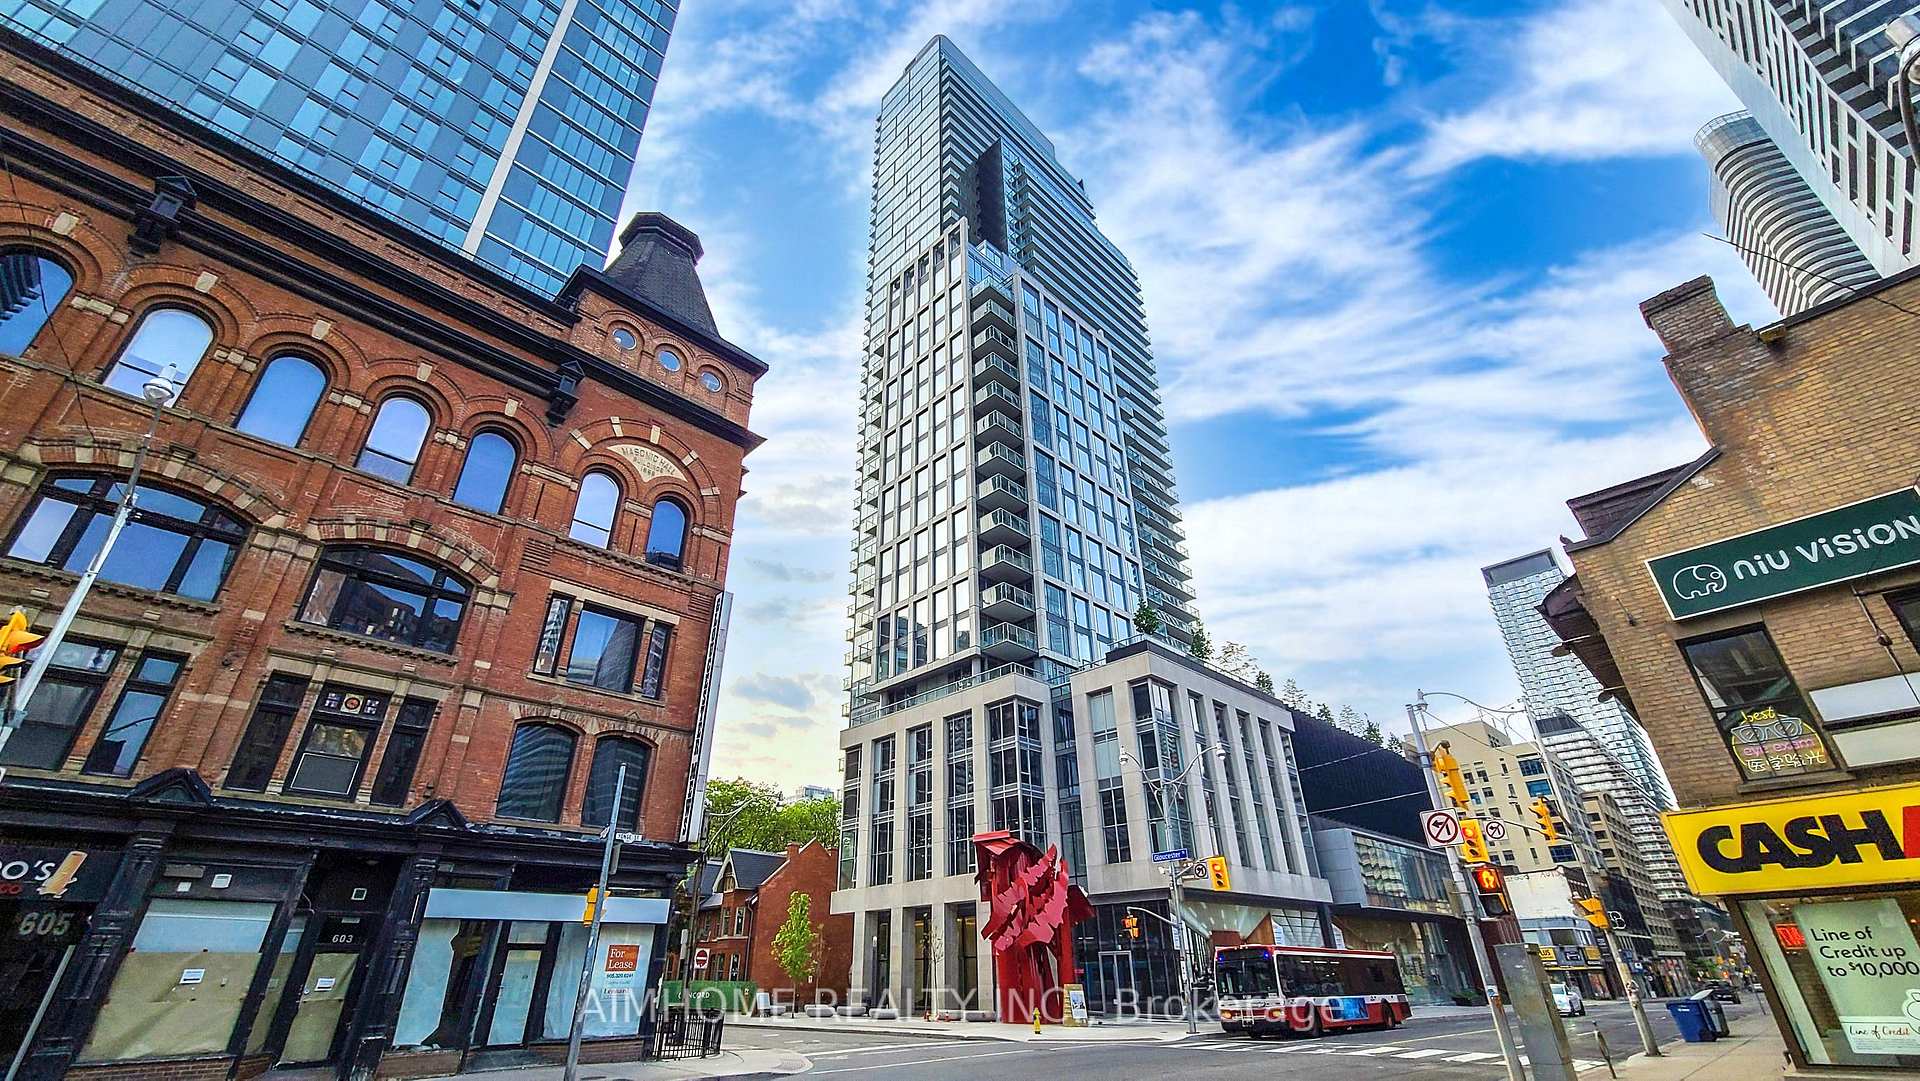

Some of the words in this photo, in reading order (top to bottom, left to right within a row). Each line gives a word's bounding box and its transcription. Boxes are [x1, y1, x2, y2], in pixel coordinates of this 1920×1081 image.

[621, 447, 659, 462] MASONIC
[660, 458, 675, 475] HALL
[1696, 809, 1905, 874] CASH
[1153, 852, 1181, 861] Gloucester
[19, 911, 73, 936] 605
[332, 934, 353, 944] 603
[1810, 928, 1851, 941] Line
[1854, 926, 1873, 940] of
[610, 949, 626, 958] For
[1819, 945, 1878, 959] Credit
[1881, 947, 1907, 960] up
[608, 959, 634, 969] Lease
[1827, 966, 1847, 977] to
[1848, 961, 1920, 979] $10,000
[678, 991, 710, 999] CNCORD
